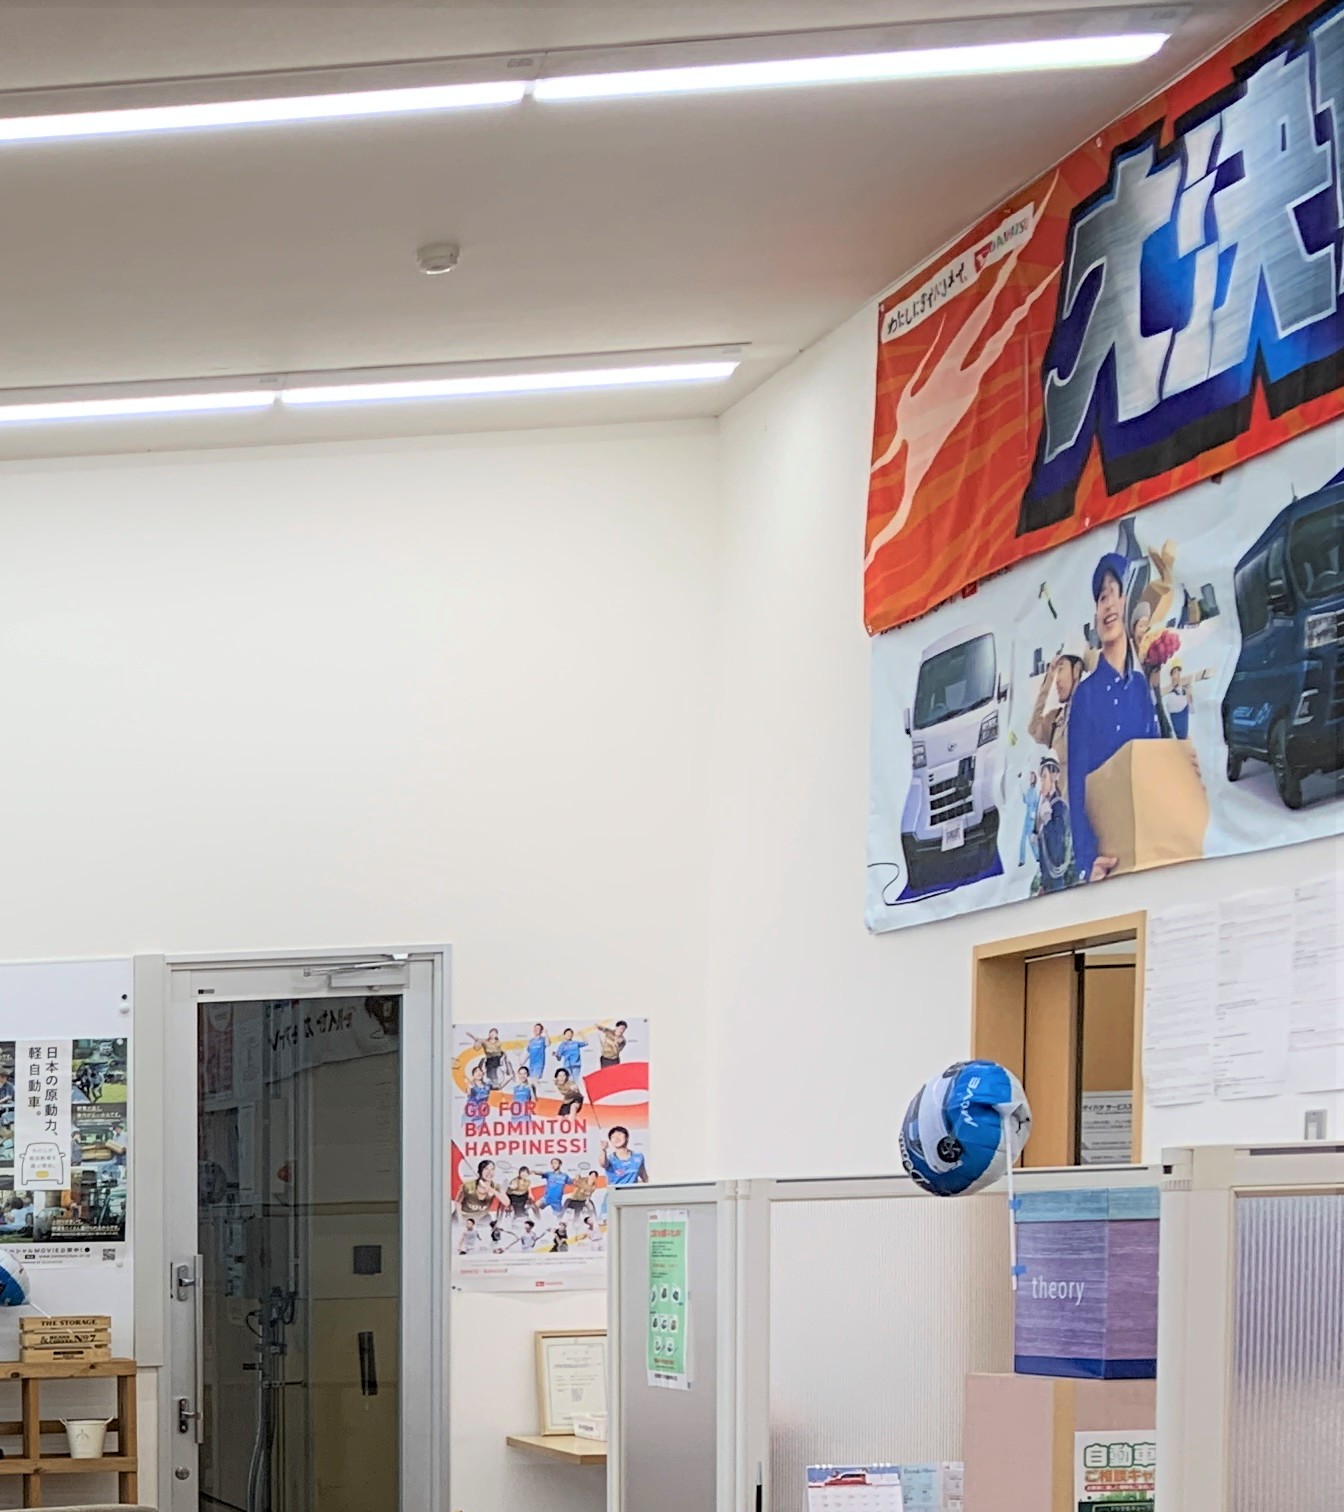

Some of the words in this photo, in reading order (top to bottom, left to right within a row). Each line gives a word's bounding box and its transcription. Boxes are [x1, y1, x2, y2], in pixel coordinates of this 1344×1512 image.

[27, 1047, 42, 1116] 軽自動車。
[45, 1047, 60, 1136] 日本の原動力、
[465, 1101, 490, 1118] GO
[499, 1101, 536, 1117] FOR
[961, 1076, 982, 1128] MOVE
[465, 1119, 588, 1137] BADMINTON
[465, 1138, 588, 1157] HAPPINESS!
[1032, 1275, 1085, 1306] theory
[59, 1319, 98, 1327] STORAGE
